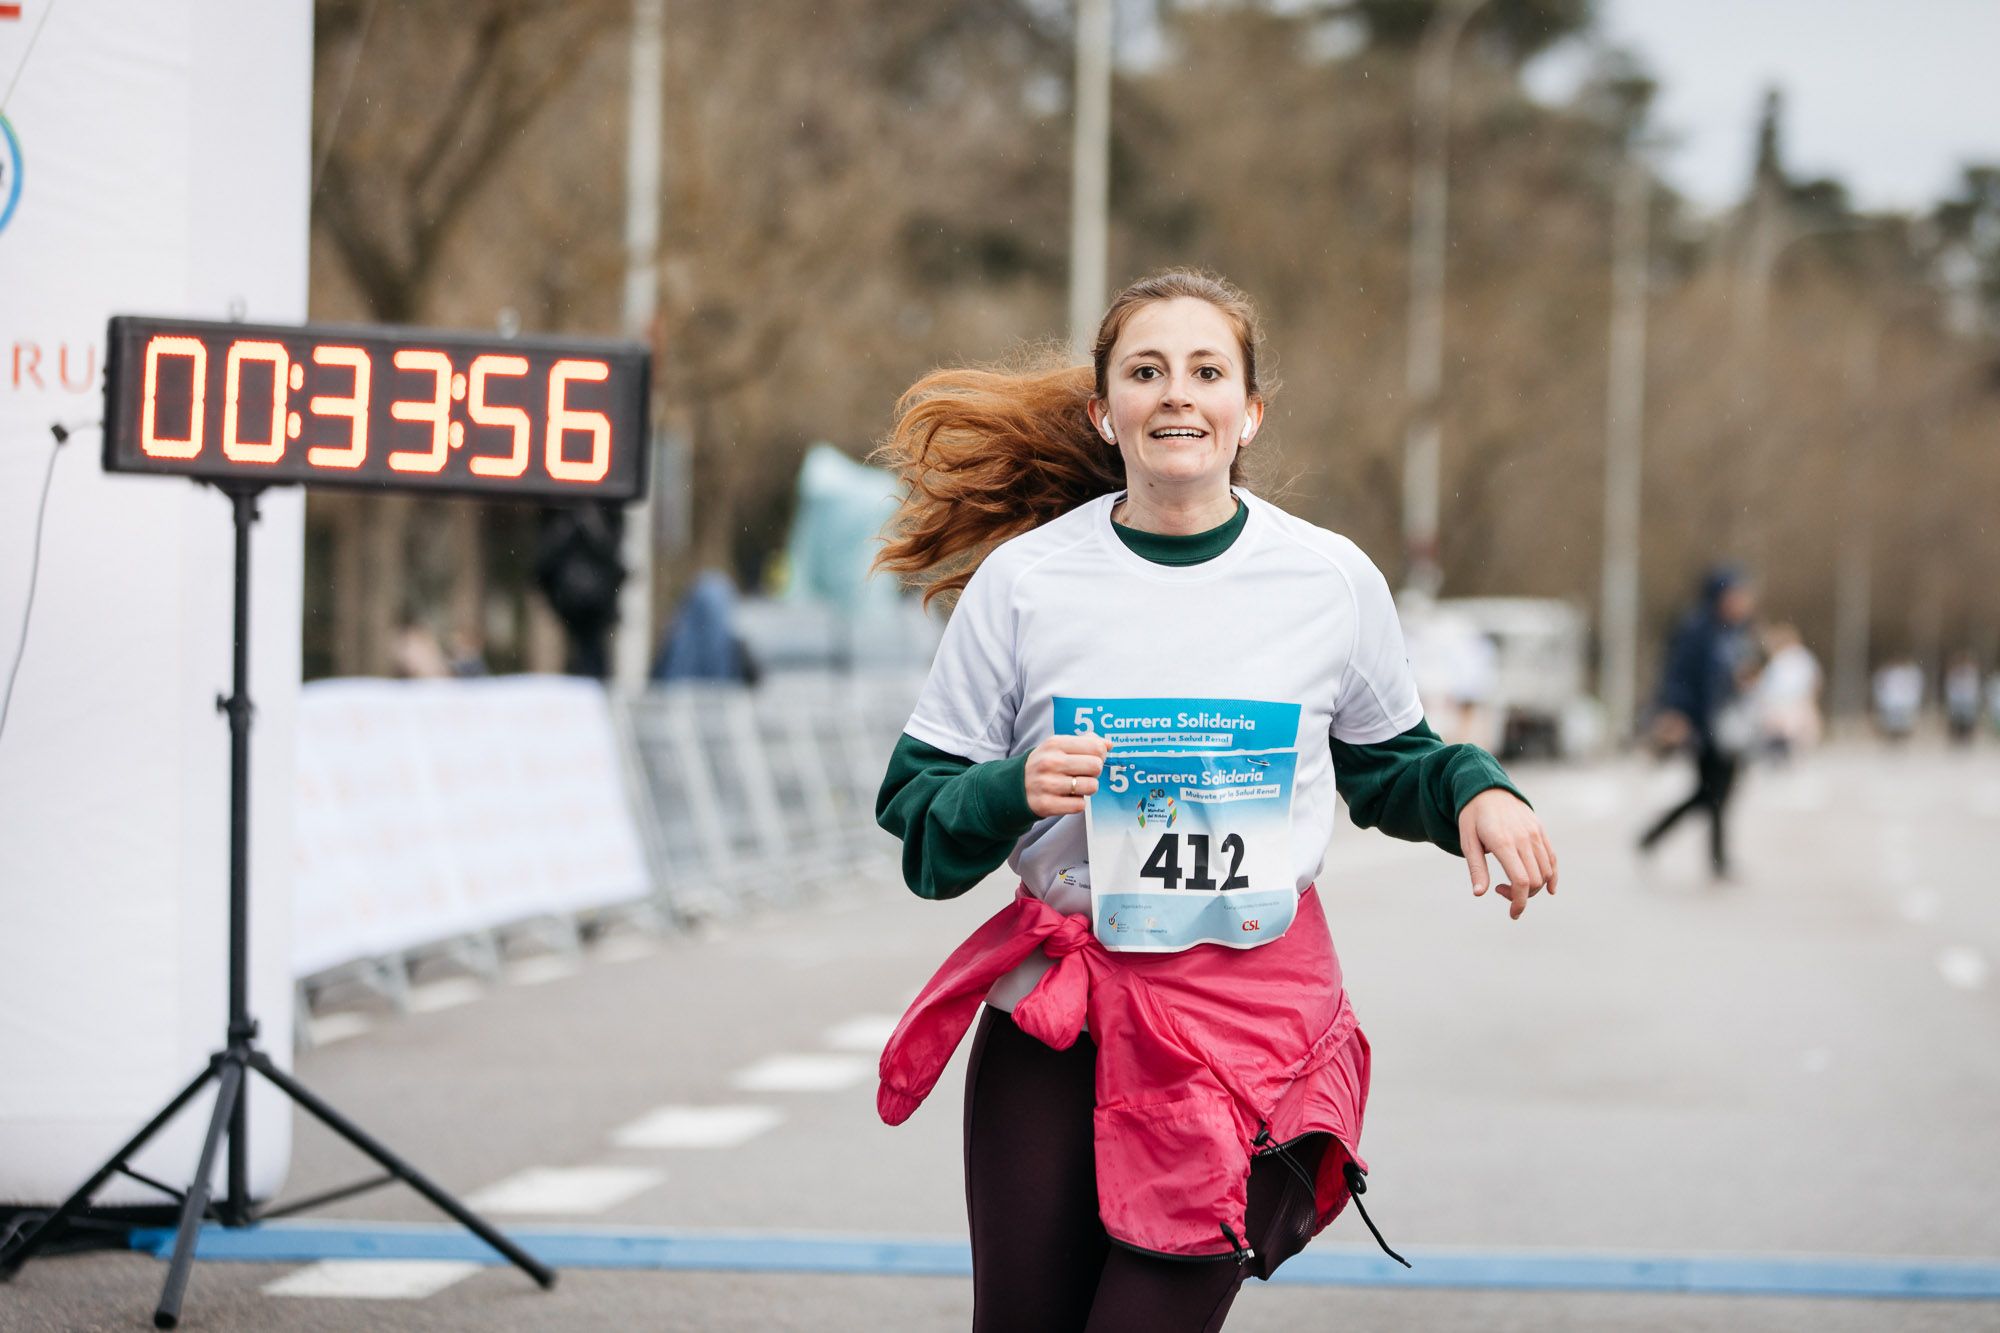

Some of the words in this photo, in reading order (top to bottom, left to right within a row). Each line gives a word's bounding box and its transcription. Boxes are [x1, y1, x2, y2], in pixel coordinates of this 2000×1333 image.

[141, 335, 612, 482] 00:33:56
[1100, 713, 1172, 729] Carrera
[1177, 711, 1256, 731] Solidaria
[1205, 735, 1229, 743] Renal
[1134, 770, 1198, 785] Carrera
[1201, 767, 1264, 786] Solidaria
[1140, 833, 1250, 891] 412
[1242, 919, 1260, 932] CSL
